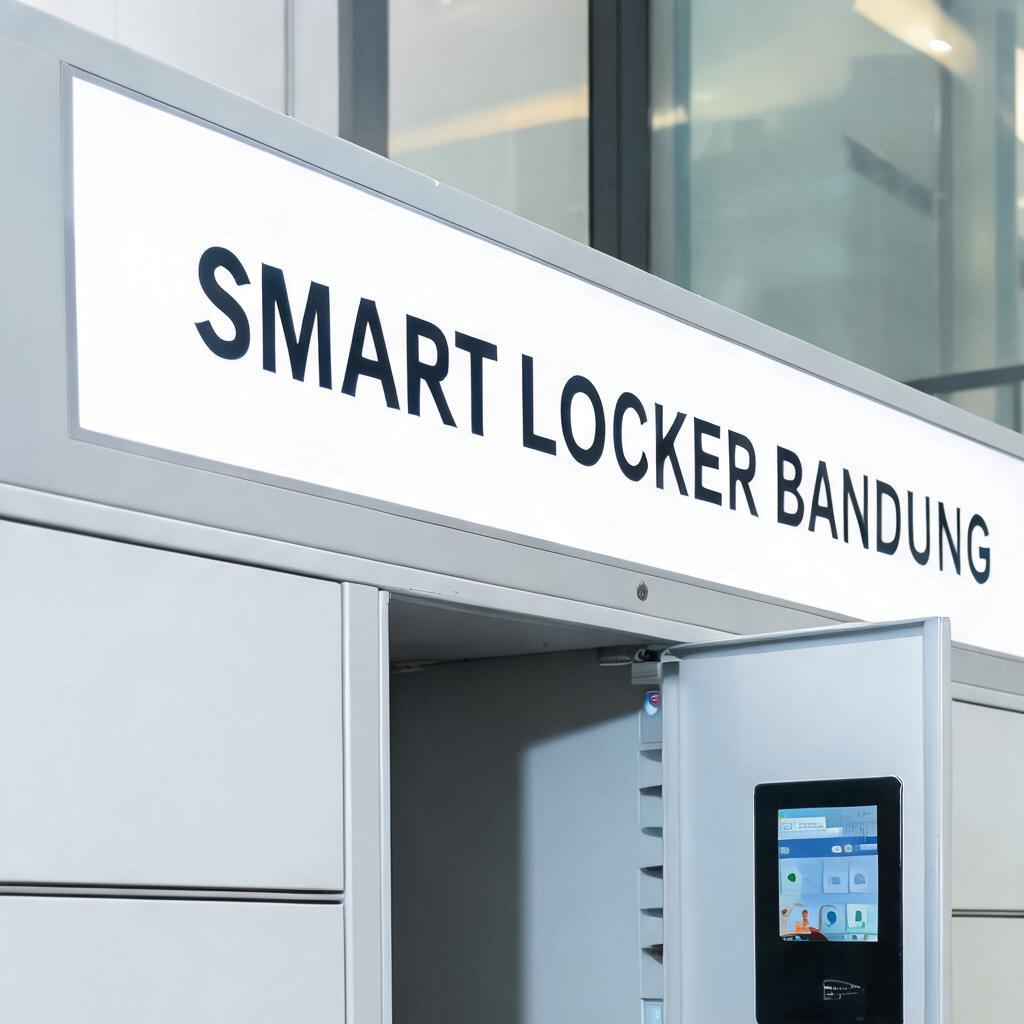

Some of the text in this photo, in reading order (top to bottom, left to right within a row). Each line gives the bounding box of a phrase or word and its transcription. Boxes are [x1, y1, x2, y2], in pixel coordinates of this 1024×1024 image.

[194, 246, 991, 585] SMART LOCKER BANDUNG
